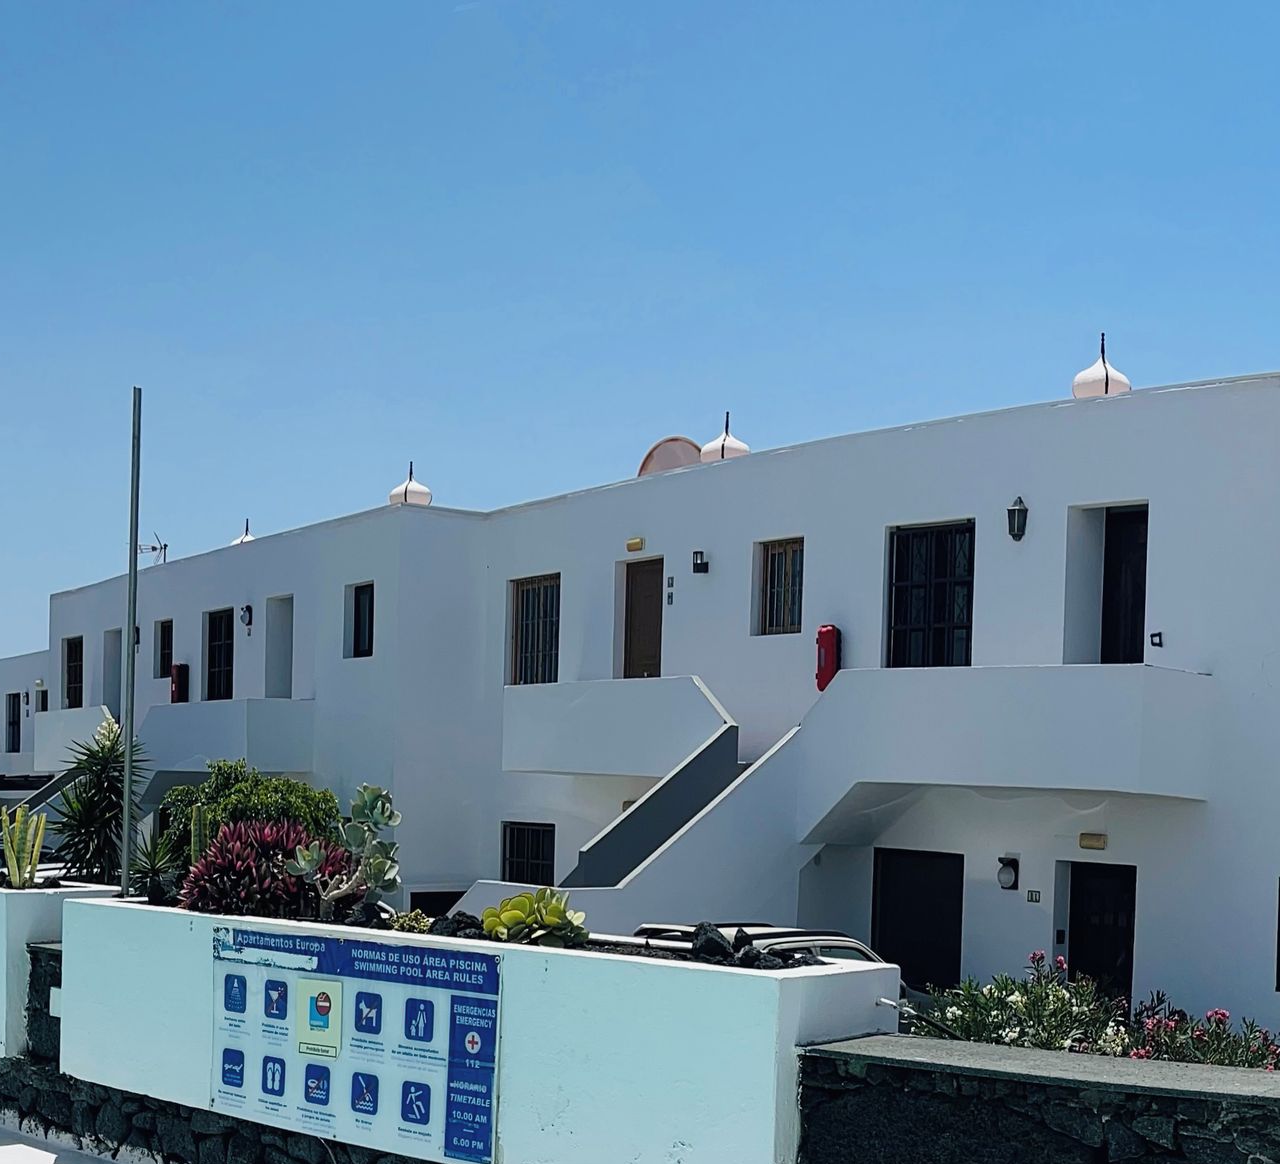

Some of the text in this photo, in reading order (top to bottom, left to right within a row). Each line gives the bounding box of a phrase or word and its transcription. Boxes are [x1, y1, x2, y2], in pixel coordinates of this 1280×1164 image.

[236, 932, 325, 953] Apartamentos Europa
[351, 949, 487, 972] NORMAS DE USO ÁREA PISCINA
[354, 961, 483, 985] SWIMMING POOL AREA RULES
[454, 1005, 495, 1017] EMERGENCIAS
[456, 1016, 492, 1028] EMERGENCY
[466, 1059, 480, 1068] 112
[453, 1081, 487, 1093] HORARIO
[450, 1094, 491, 1107] TIMETABLE
[452, 1111, 487, 1123] 10.00 AM
[453, 1137, 483, 1149] 6.00 PM
